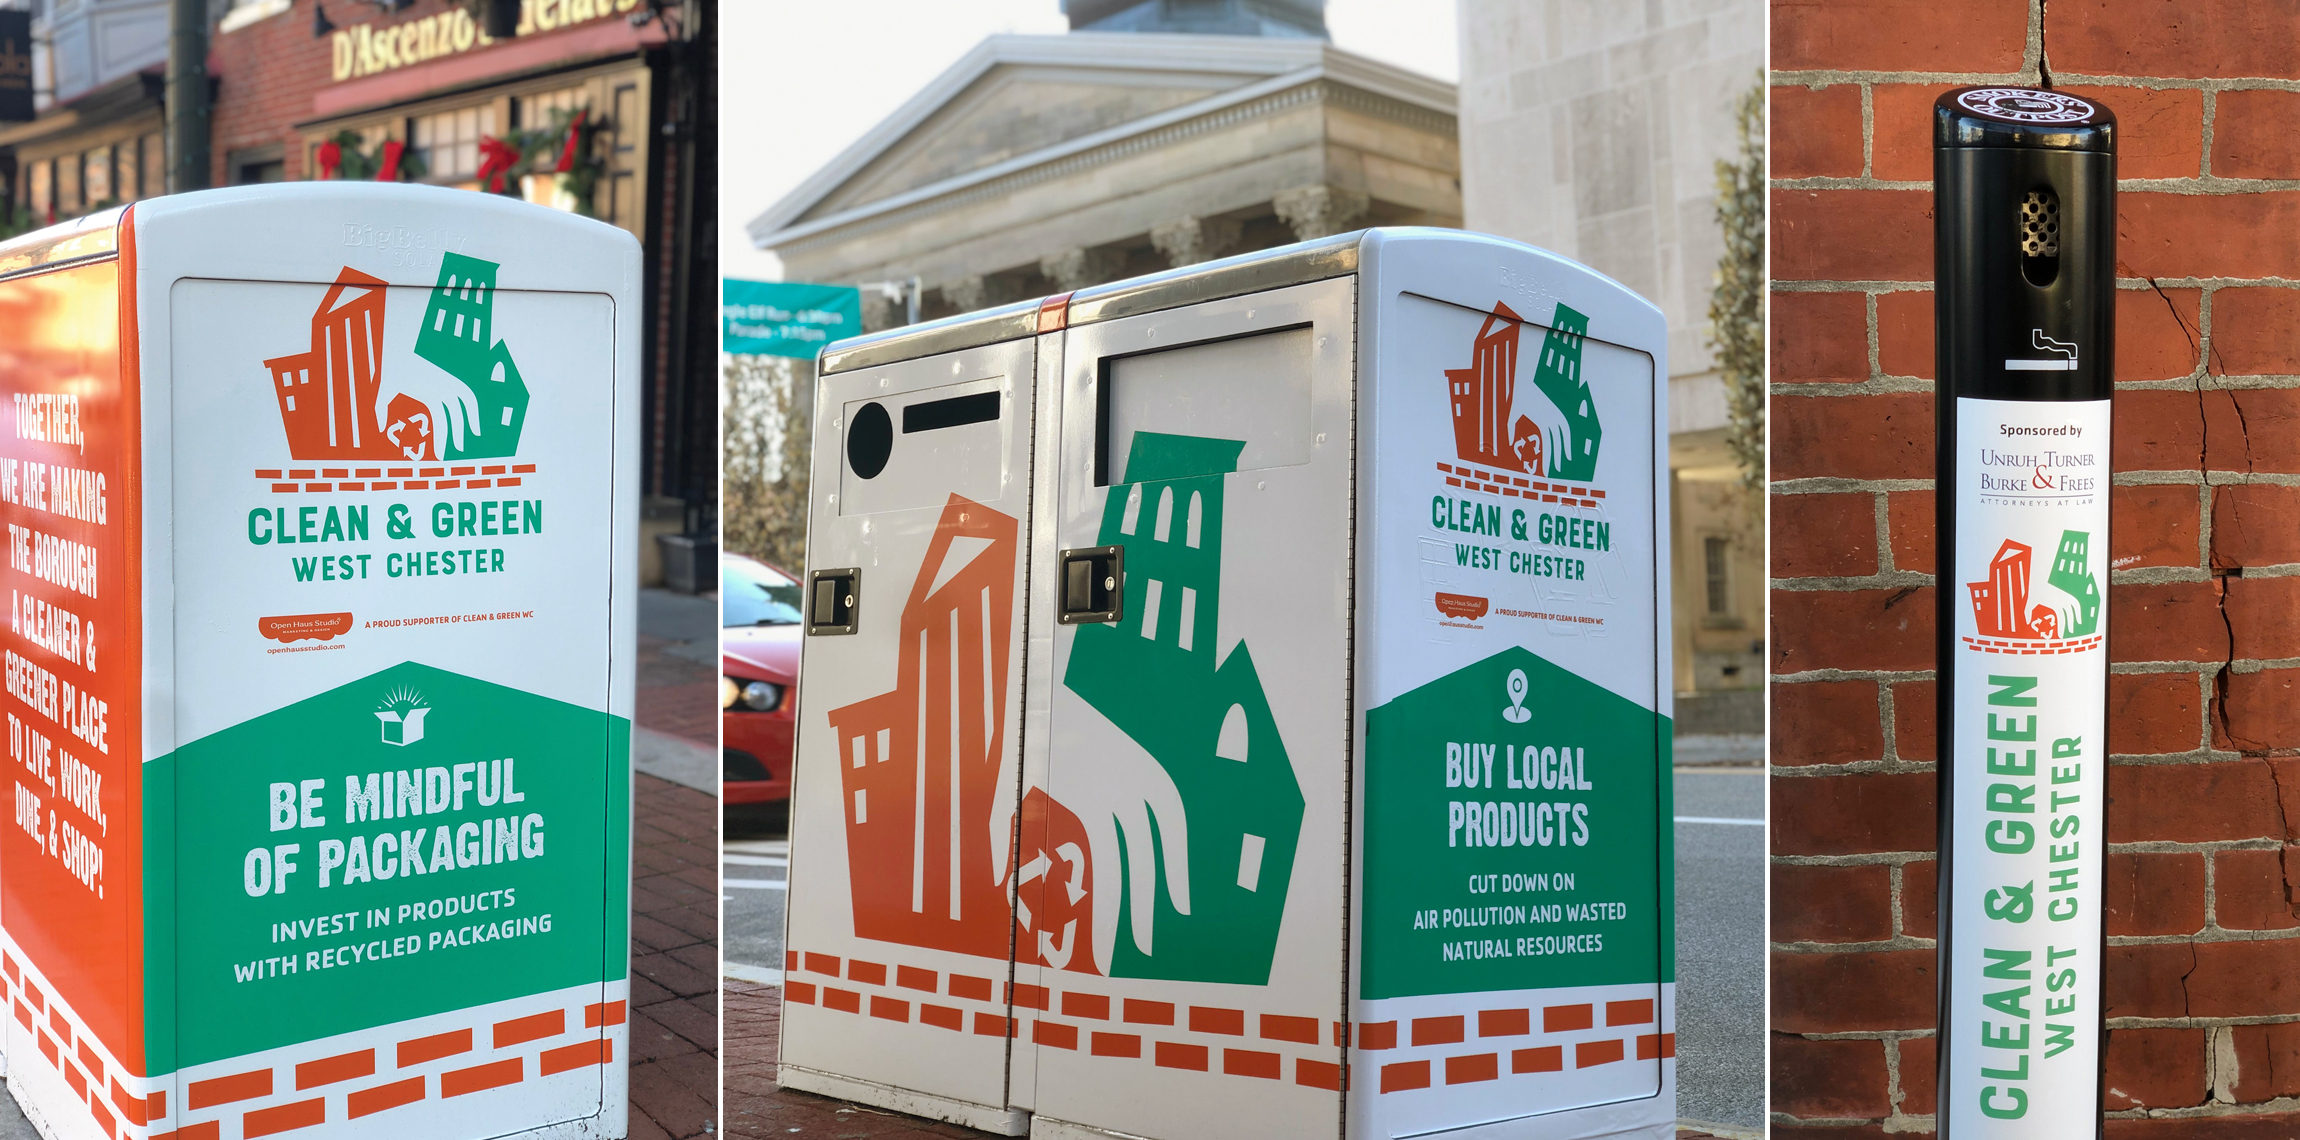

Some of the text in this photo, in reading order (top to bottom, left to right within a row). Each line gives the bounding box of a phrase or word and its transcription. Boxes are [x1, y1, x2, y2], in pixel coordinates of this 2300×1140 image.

[14, 393, 84, 456] TOGETHER,
[2000, 424, 2082, 438] Sponsored by
[1981, 448, 2095, 468] UNRUH TURNER
[1981, 464, 2095, 491] BURKE & FREES
[0, 457, 107, 525] WE ARE MAKING
[1980, 498, 2094, 507] ATTORNEYS AT LAW
[248, 500, 542, 545] CLEAN & GREEN
[1432, 495, 1610, 552] CLEAN & GREEN
[9, 523, 97, 600] THE BOROUGH
[292, 549, 504, 582] WEST CHESTER
[1455, 543, 1585, 581] WEST CHESTER
[12, 589, 96, 673] A CLEANER &
[270, 621, 292, 630] Open
[293, 620, 313, 628] Haus
[372, 619, 401, 628] PROUD
[403, 616, 449, 626] SUPPORTER
[451, 615, 462, 623] OF
[463, 613, 487, 622] CLEAN
[496, 611, 521, 620] GREEN
[522, 610, 534, 618] WC
[1499, 608, 1518, 617] PROUD
[1518, 610, 1547, 620] SUPPORTER
[1548, 613, 1555, 621] OF
[1556, 614, 1573, 623] CLEAN
[1573, 615, 1578, 623] &
[1578, 616, 1595, 624] GREEN
[267, 644, 345, 655] openhausstudio.com
[5, 649, 108, 755] GREENER PLACE
[8, 712, 107, 838] TO LIVE, WORK,
[1446, 741, 1593, 791] BUY LOCAL
[270, 758, 525, 832] BE MINDFUL
[16, 780, 103, 899] DINE, & SHOP!
[1448, 801, 1590, 848] PRODUCTS
[244, 813, 544, 897] OF PACKAGING
[1468, 872, 1575, 894] CUT DOWN ON
[1979, 674, 2039, 1121] CLEAN & GREEN
[2044, 735, 2083, 1060] WEST CHESTER
[272, 888, 516, 943] INVEST IN PRODUCTS
[1413, 902, 1627, 930] AIR POLLUTION AND WASTED
[234, 913, 552, 983] WITH RECYCLED PACKAGING
[1442, 933, 1603, 962] NATURAL RESOURCES
